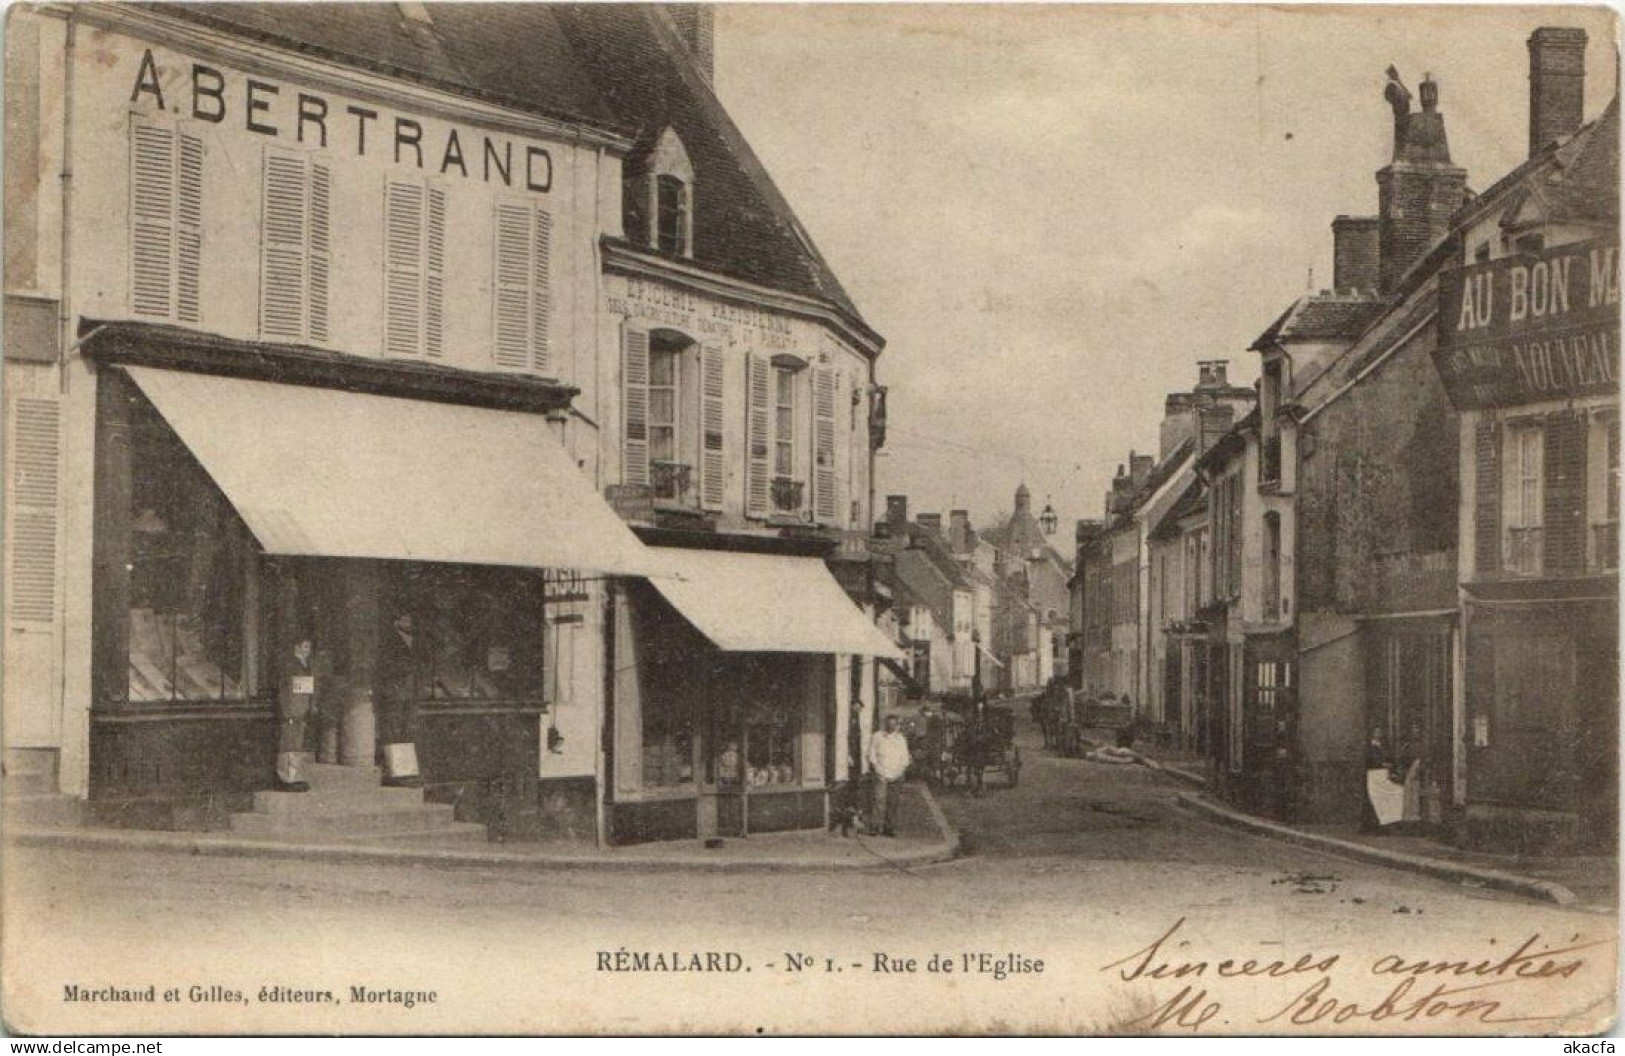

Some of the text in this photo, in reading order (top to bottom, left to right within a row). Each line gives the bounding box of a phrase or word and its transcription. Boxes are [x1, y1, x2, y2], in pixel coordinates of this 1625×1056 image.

[191, 62, 554, 194] BERTRAND
[1457, 272, 1494, 331] AU
[1510, 255, 1571, 321] BON
